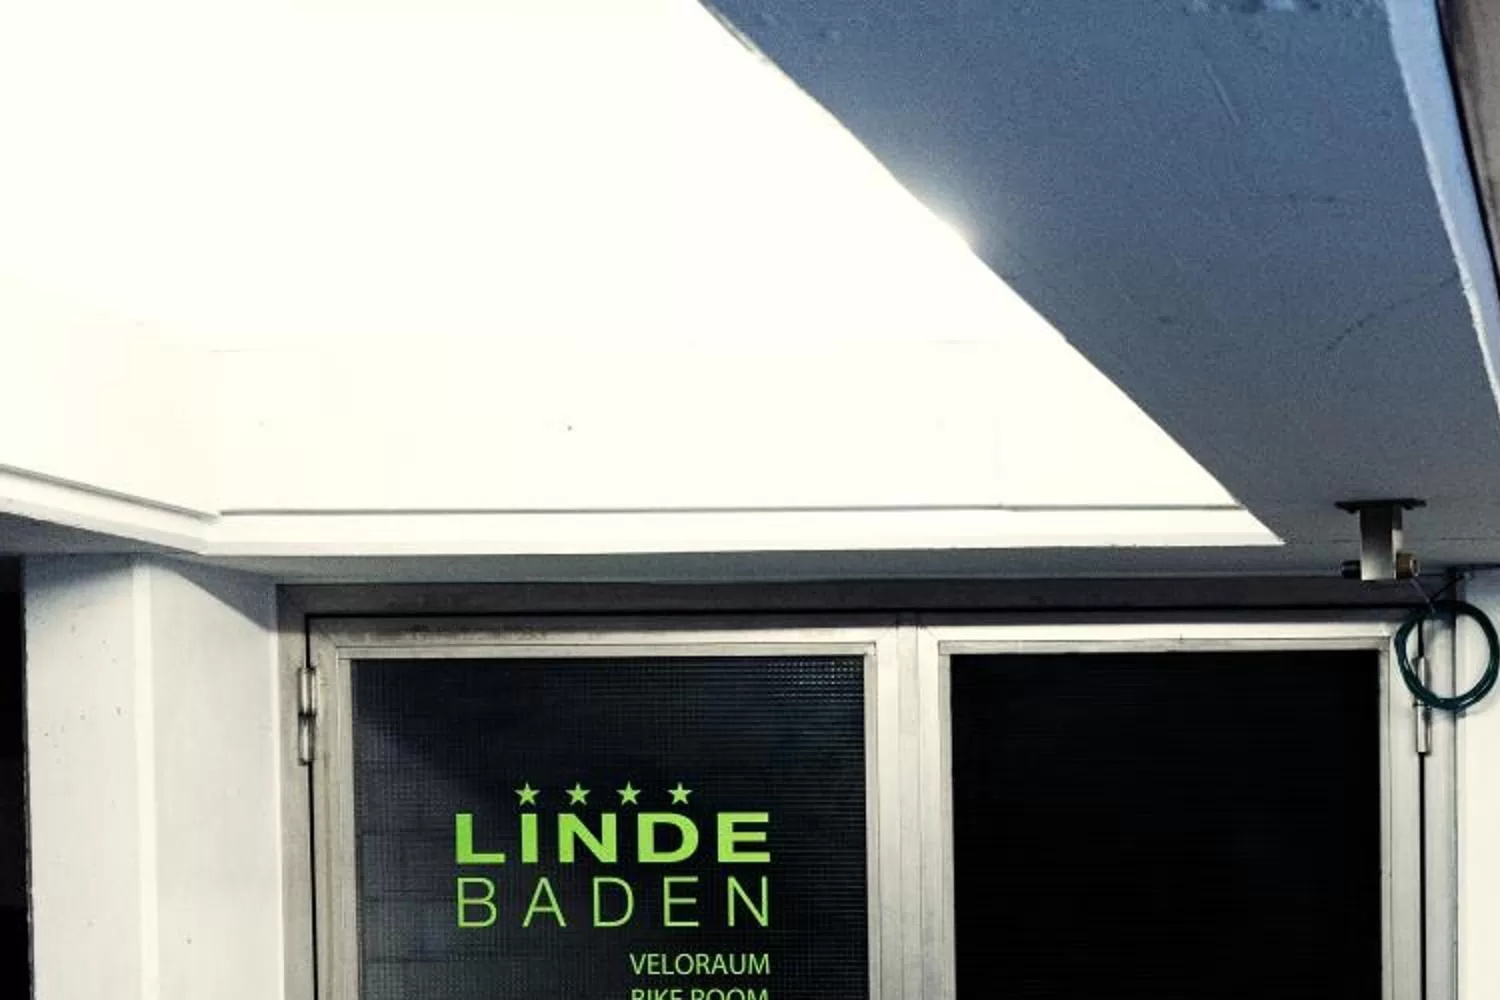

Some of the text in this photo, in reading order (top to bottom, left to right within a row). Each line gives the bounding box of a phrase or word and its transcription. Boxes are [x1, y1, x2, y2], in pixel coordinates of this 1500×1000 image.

[455, 812, 770, 863] LINDE
[456, 875, 770, 929] BADEN
[629, 953, 771, 976] VELORAUM
